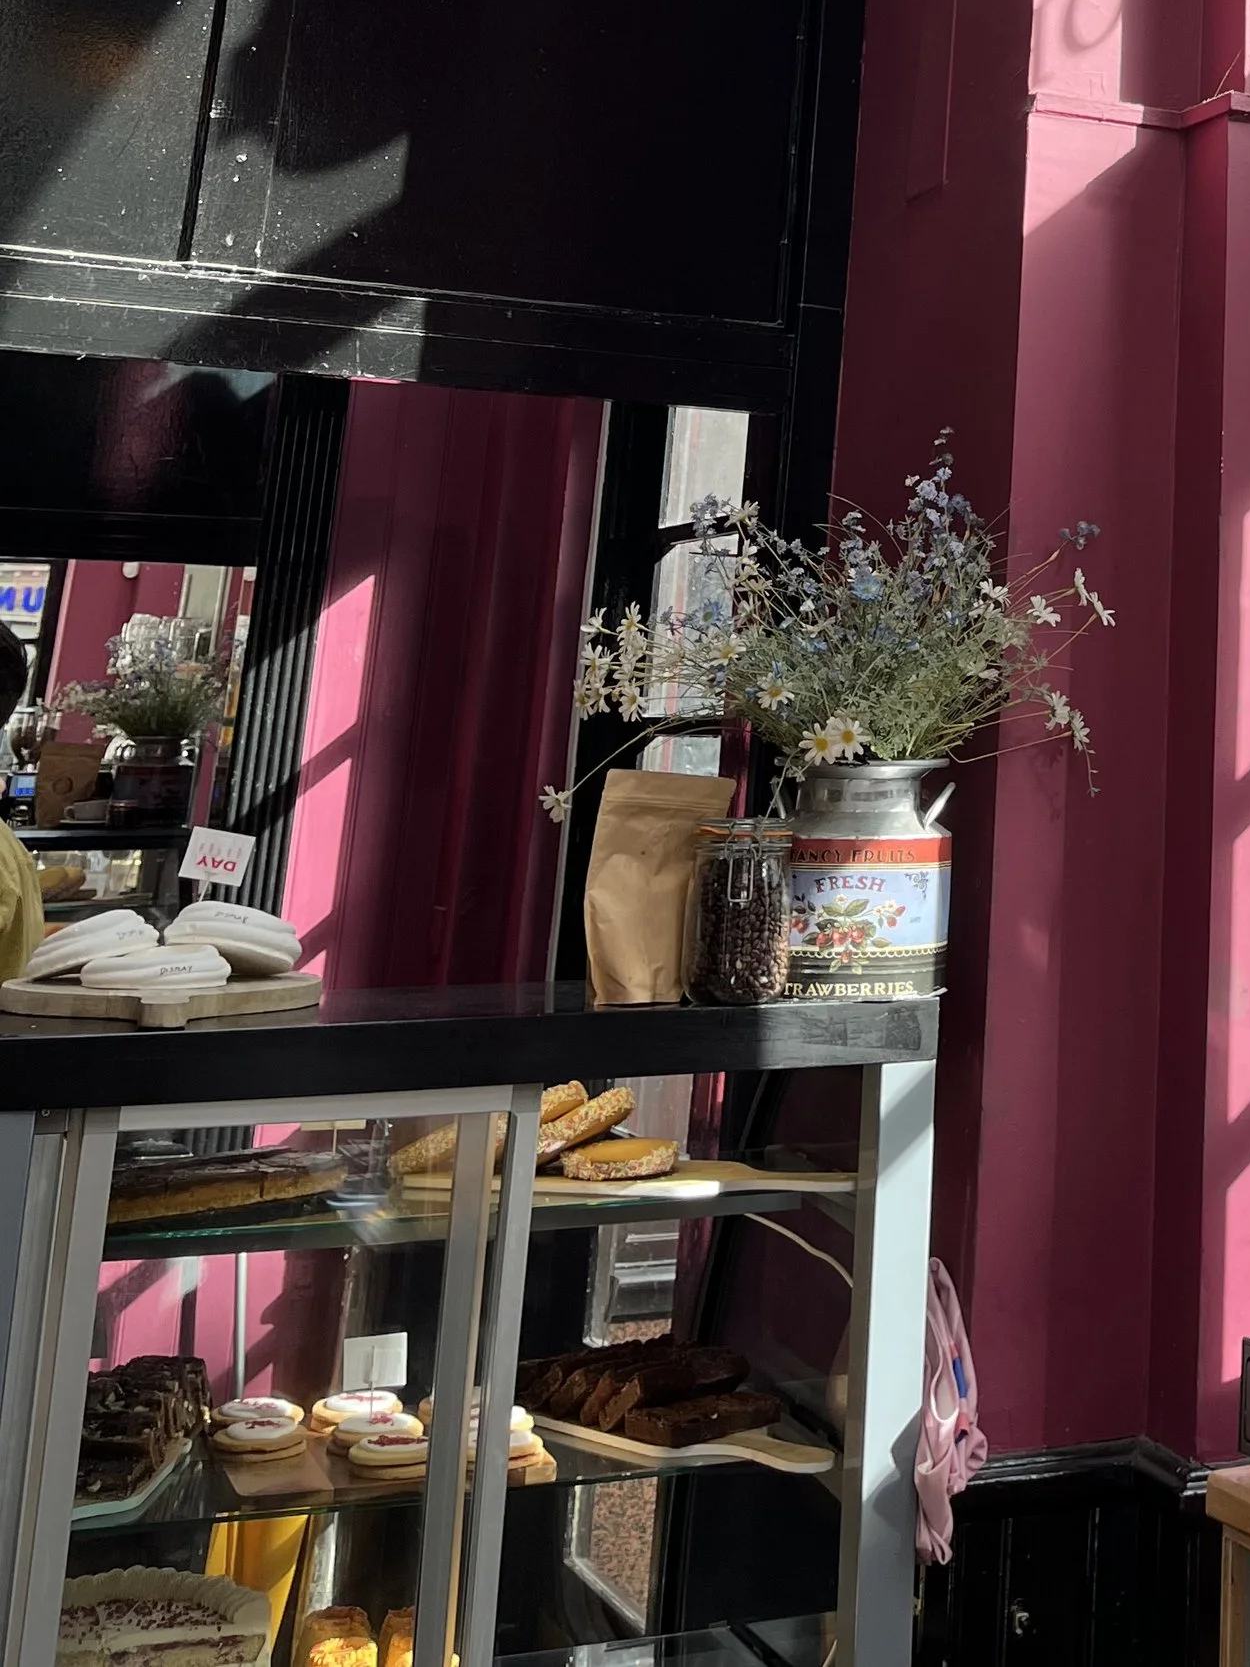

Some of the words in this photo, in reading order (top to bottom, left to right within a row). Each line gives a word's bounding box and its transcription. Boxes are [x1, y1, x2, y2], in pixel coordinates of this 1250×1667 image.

[196, 855, 237, 872] DAY
[850, 848, 916, 863] FRUITS
[814, 874, 886, 894] FRESH
[783, 980, 917, 998] TRAWBERRIES
